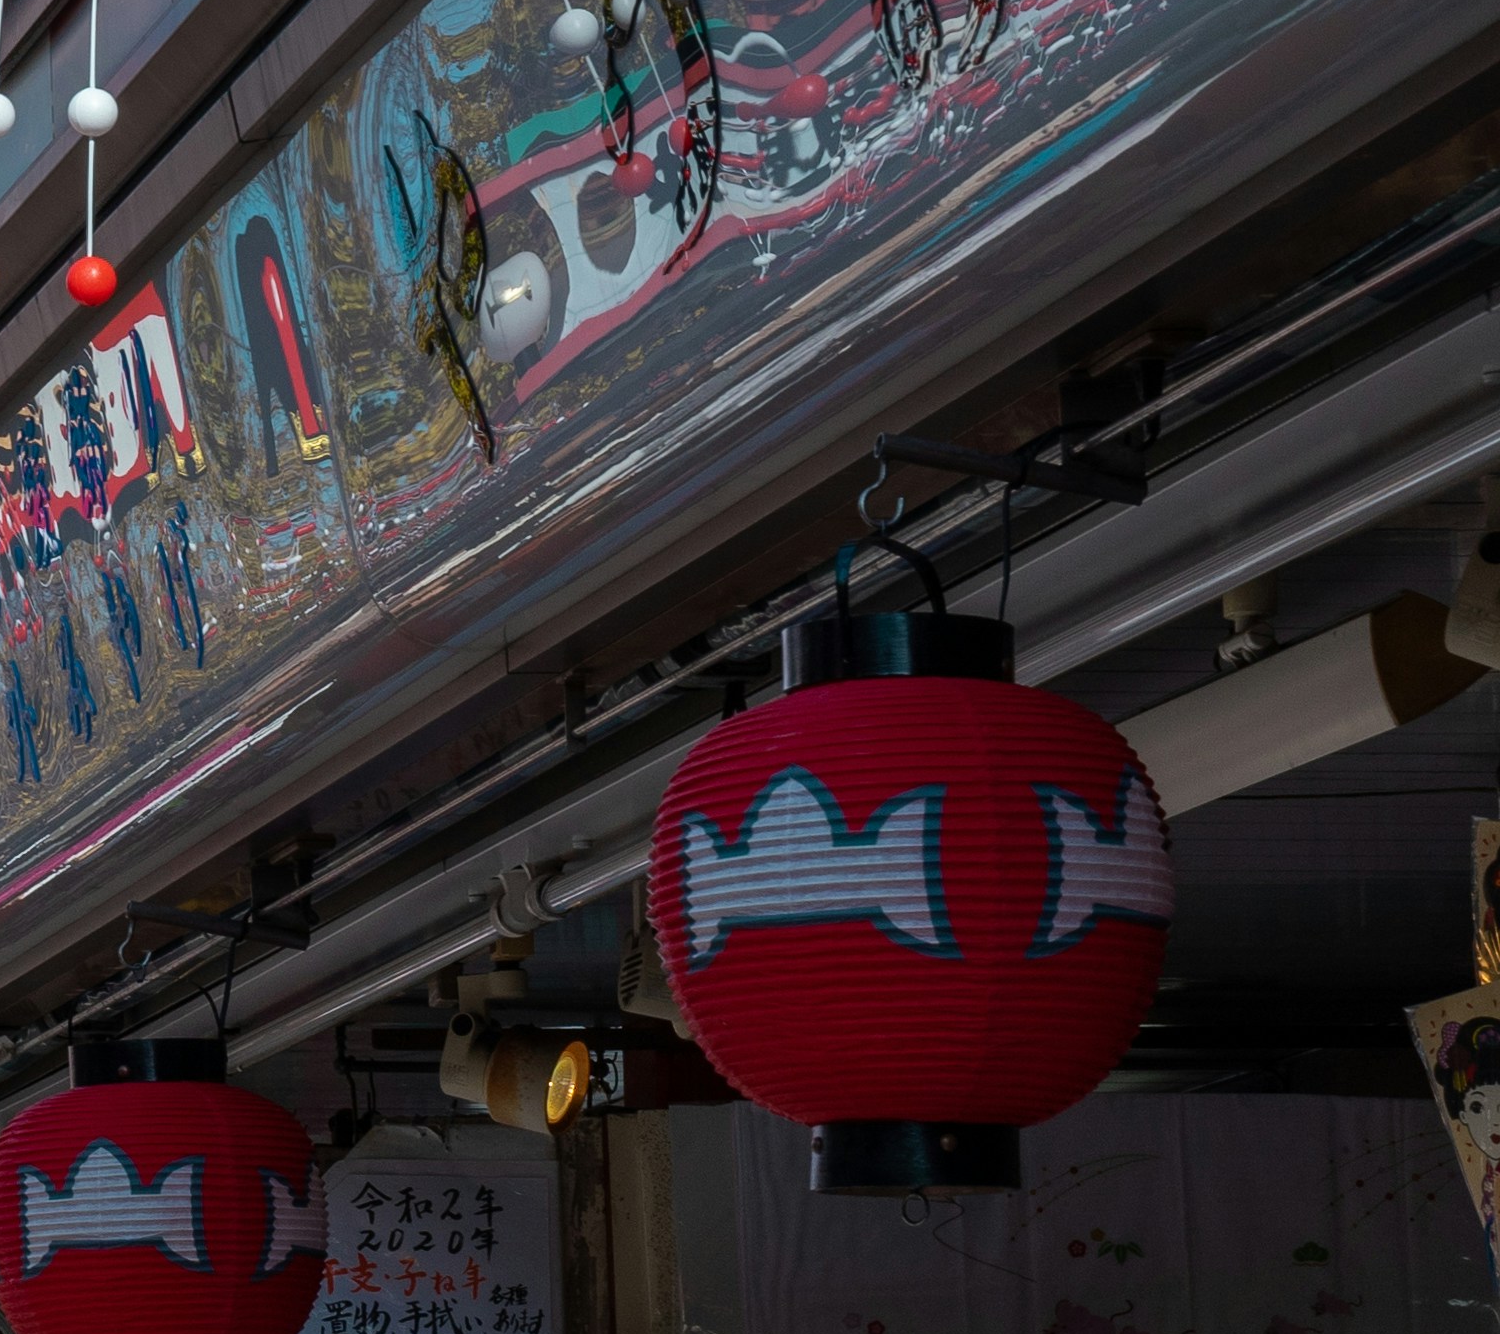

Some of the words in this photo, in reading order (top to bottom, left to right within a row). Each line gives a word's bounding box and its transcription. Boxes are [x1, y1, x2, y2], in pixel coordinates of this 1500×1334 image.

[351, 1181, 503, 1226] 令和2年
[357, 1228, 499, 1262] 2020年
[489, 1284, 528, 1307] 各種
